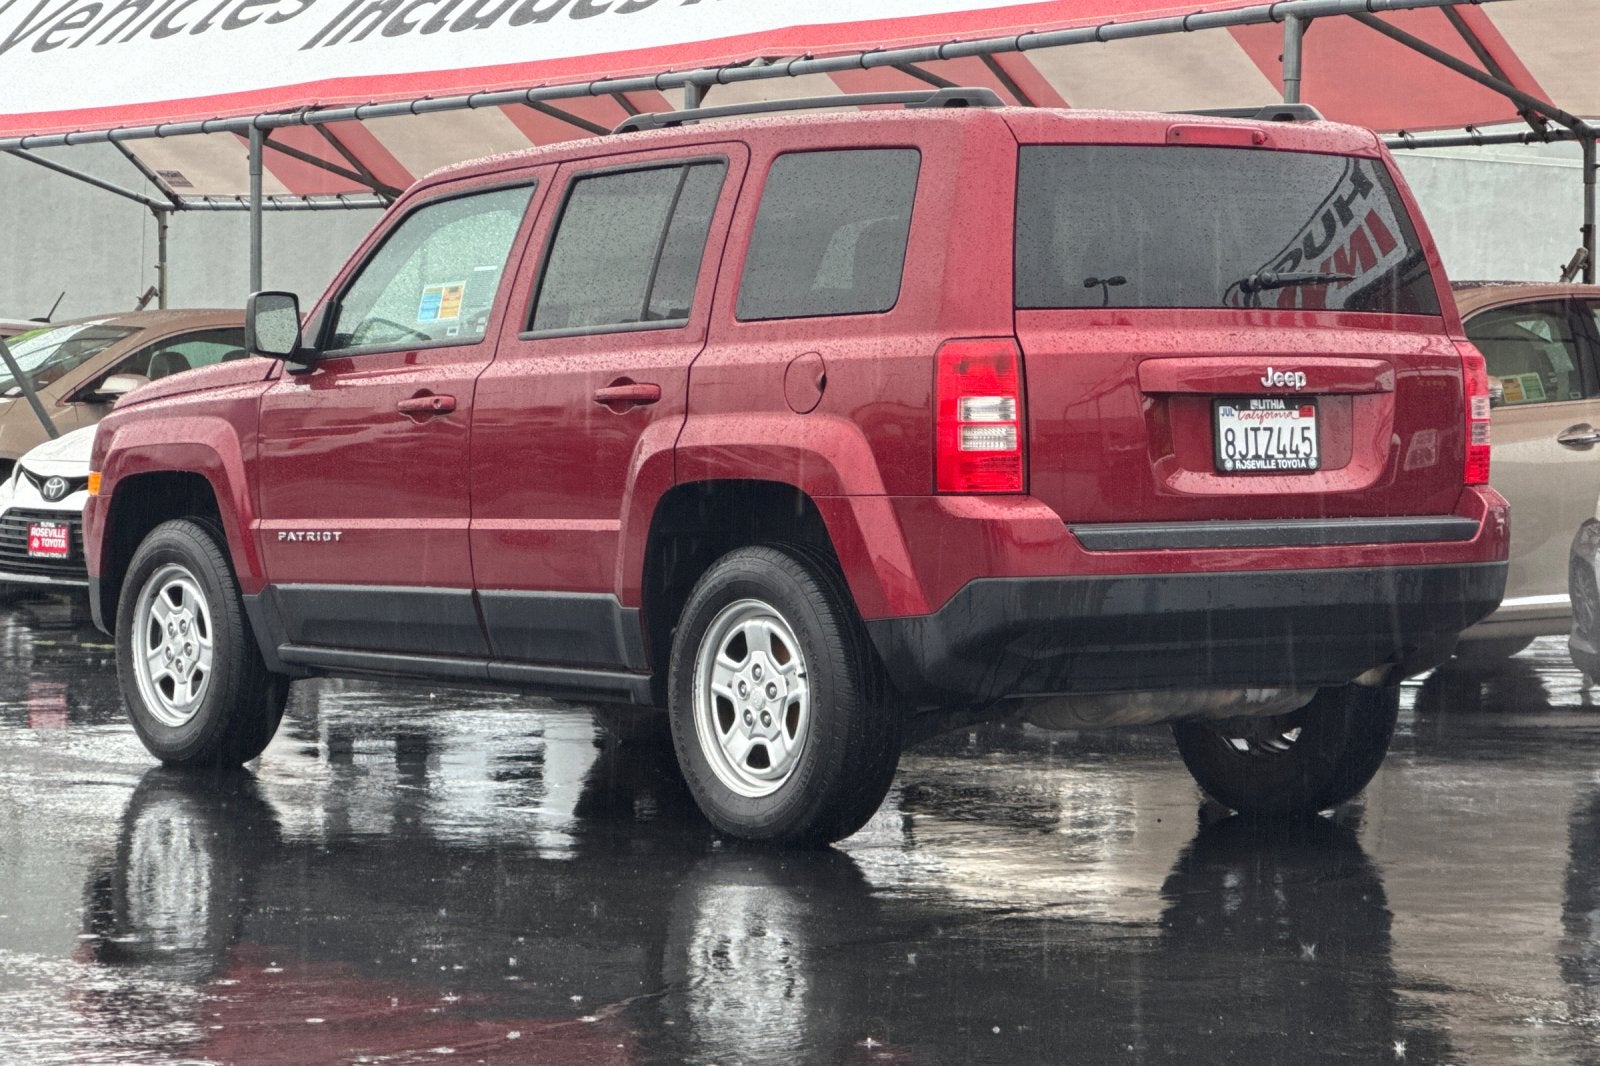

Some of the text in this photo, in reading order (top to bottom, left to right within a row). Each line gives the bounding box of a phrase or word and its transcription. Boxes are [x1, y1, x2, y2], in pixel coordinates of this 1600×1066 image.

[1261, 367, 1307, 390] Jeep
[1258, 400, 1285, 410] LITHIA
[1238, 410, 1299, 424] California
[1235, 459, 1306, 469] ROSEVILLE TOYOTA
[30, 527, 66, 538] ROSEVILLE
[278, 531, 342, 541] PATRIOT
[41, 538, 66, 548] TOYOTA
